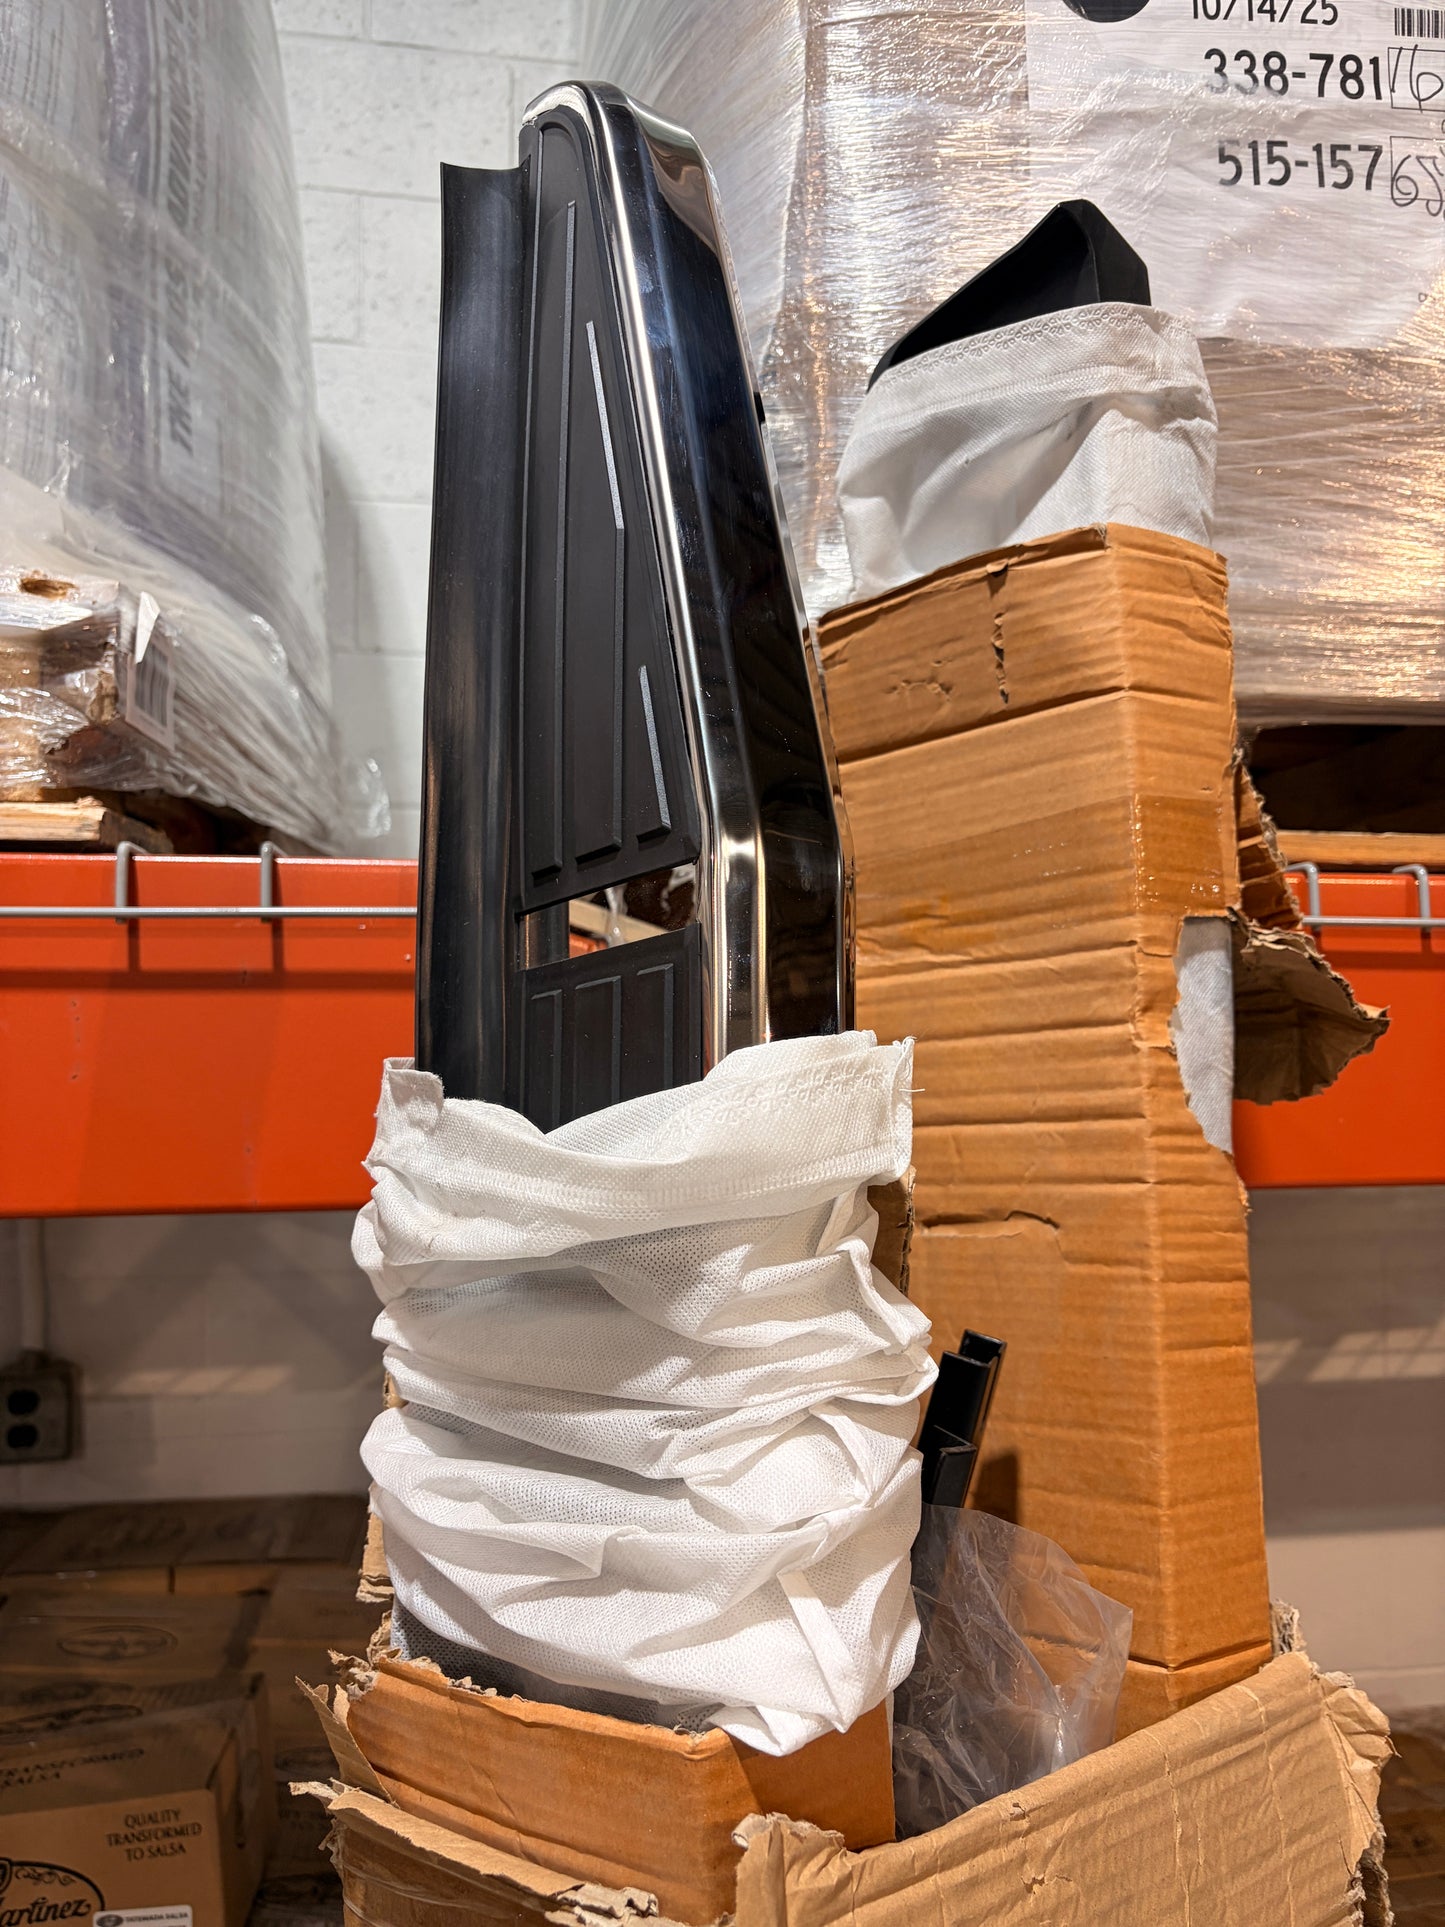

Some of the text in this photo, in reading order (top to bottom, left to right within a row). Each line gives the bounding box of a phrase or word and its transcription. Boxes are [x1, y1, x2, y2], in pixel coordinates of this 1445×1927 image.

[1193, 0, 1338, 25] 10/14/25
[1204, 48, 1383, 100] 338-781
[1218, 140, 1383, 191] 515-157
[124, 1808, 181, 1829] QUALITY
[105, 1822, 202, 1847] TRANSFORMED
[125, 1843, 187, 1861] TO SALSA
[0, 1897, 92, 1927] artinez
